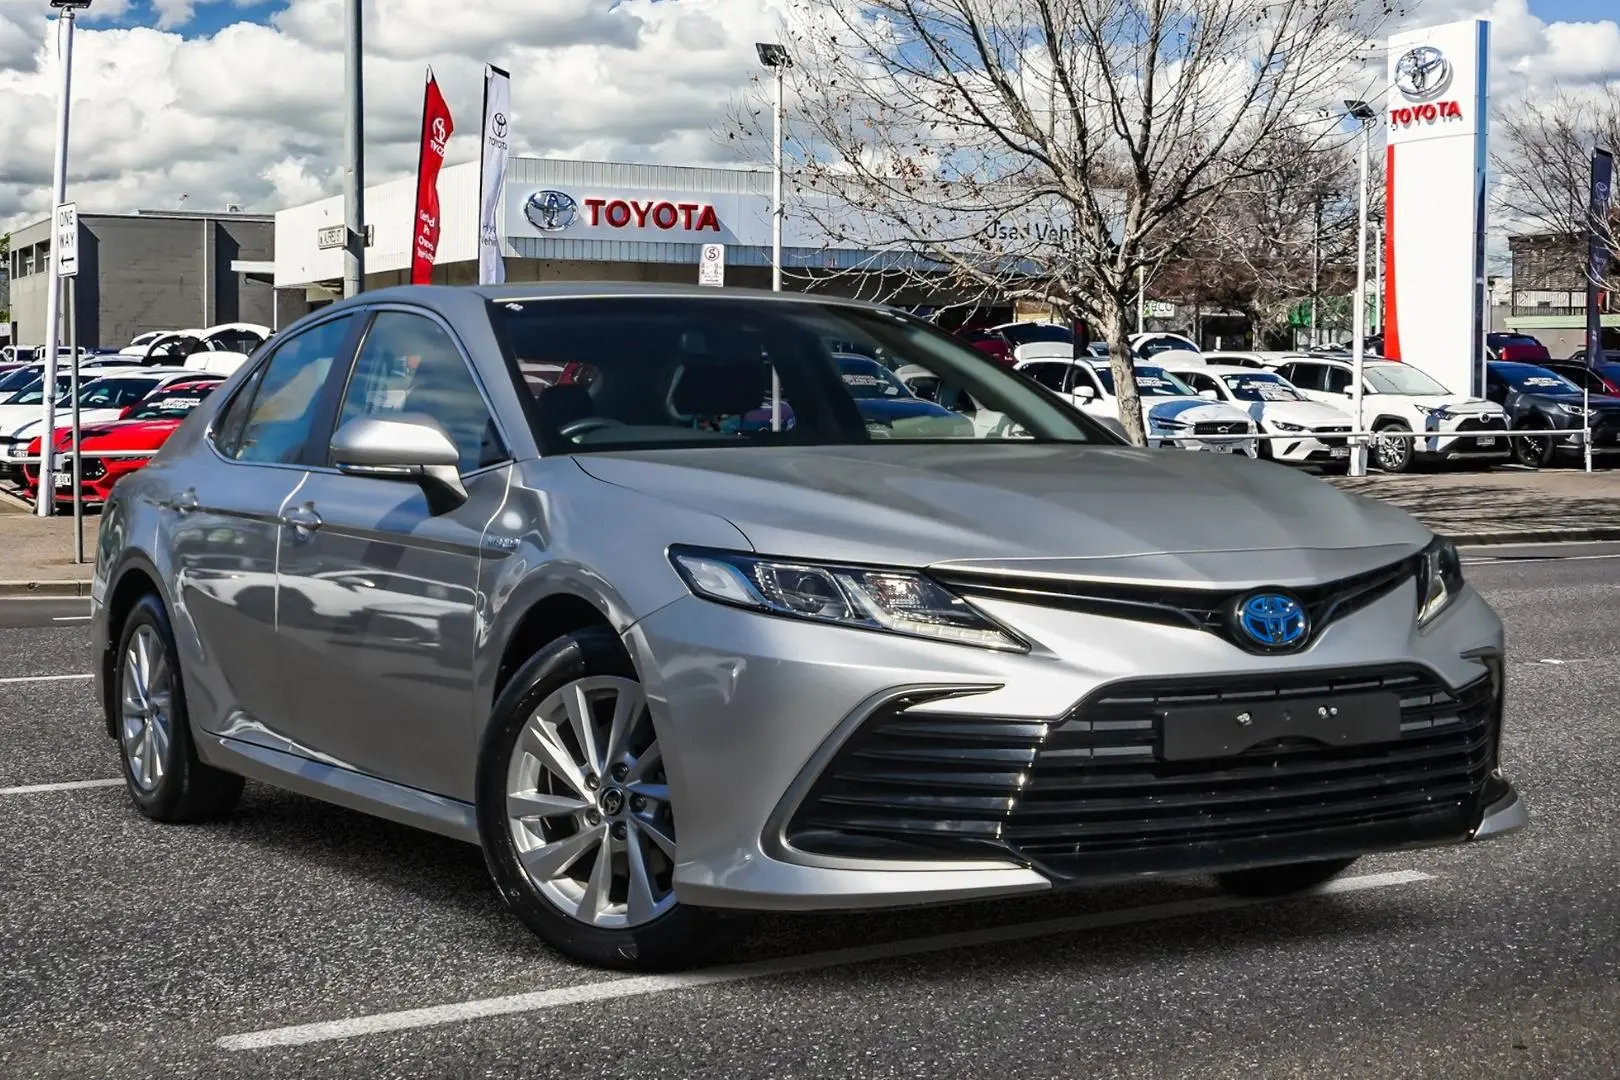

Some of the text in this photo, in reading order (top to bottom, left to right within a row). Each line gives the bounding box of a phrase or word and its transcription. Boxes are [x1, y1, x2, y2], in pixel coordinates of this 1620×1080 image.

[1389, 101, 1461, 124] TOYOTA
[60, 210, 74, 227] ONE
[584, 199, 721, 232] TOYOTA
[59, 231, 75, 249] WAY
